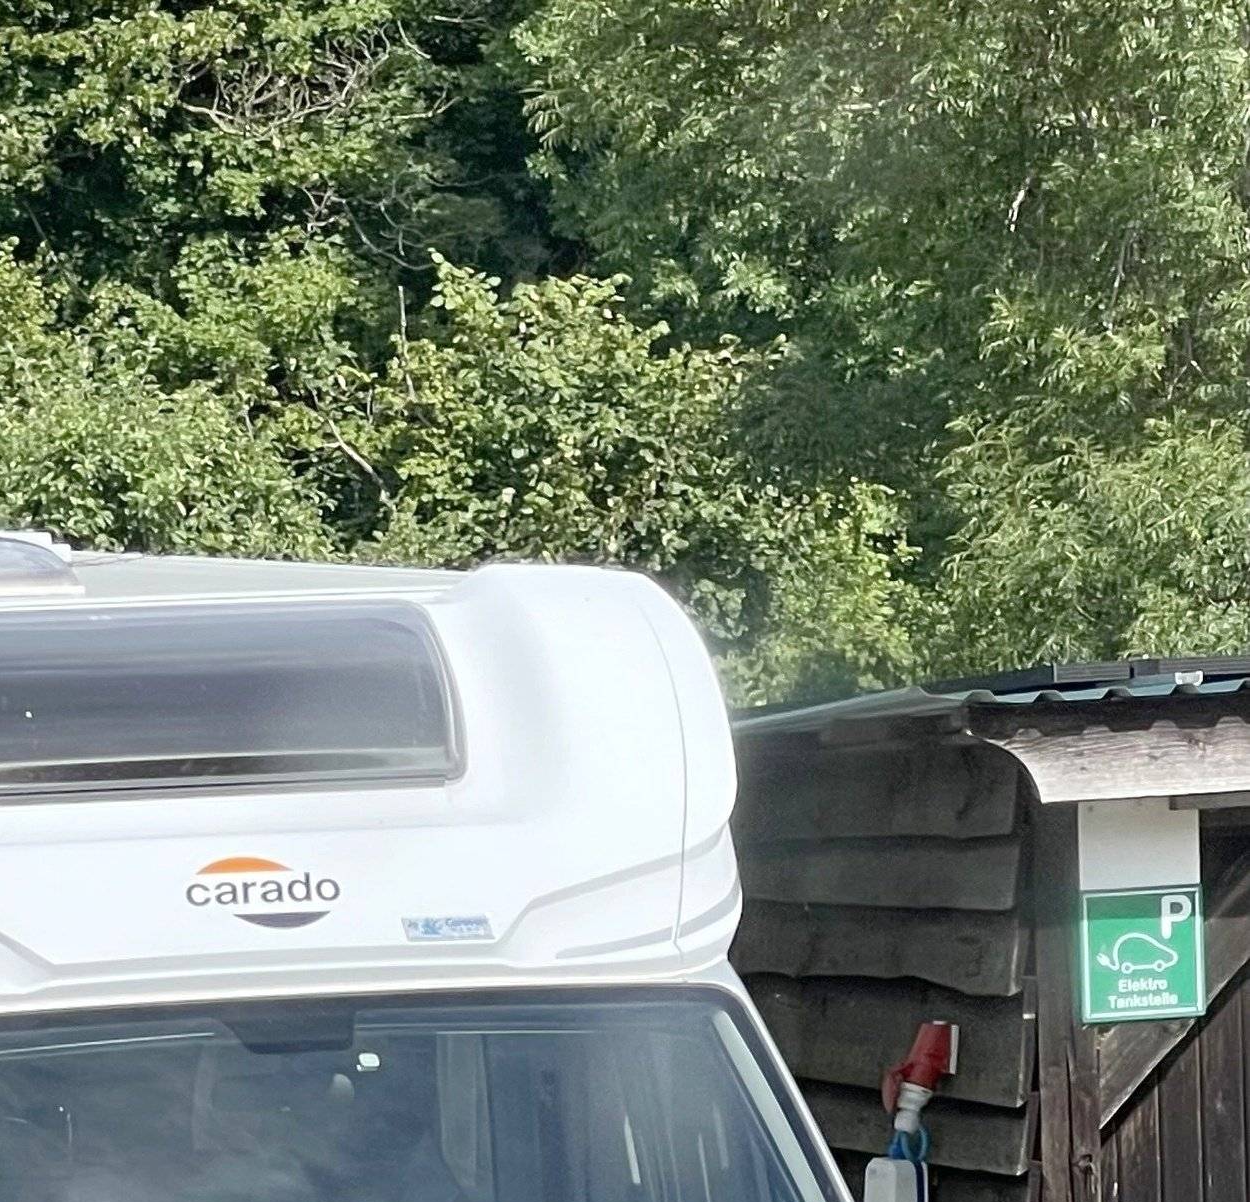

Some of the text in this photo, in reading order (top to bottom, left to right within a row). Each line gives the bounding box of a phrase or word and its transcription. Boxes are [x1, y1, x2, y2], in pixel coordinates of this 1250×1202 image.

[185, 872, 341, 907] carado
[1161, 894, 1192, 940] P
[1118, 978, 1168, 993] Elektro
[1108, 992, 1179, 1009] Tankstelle
